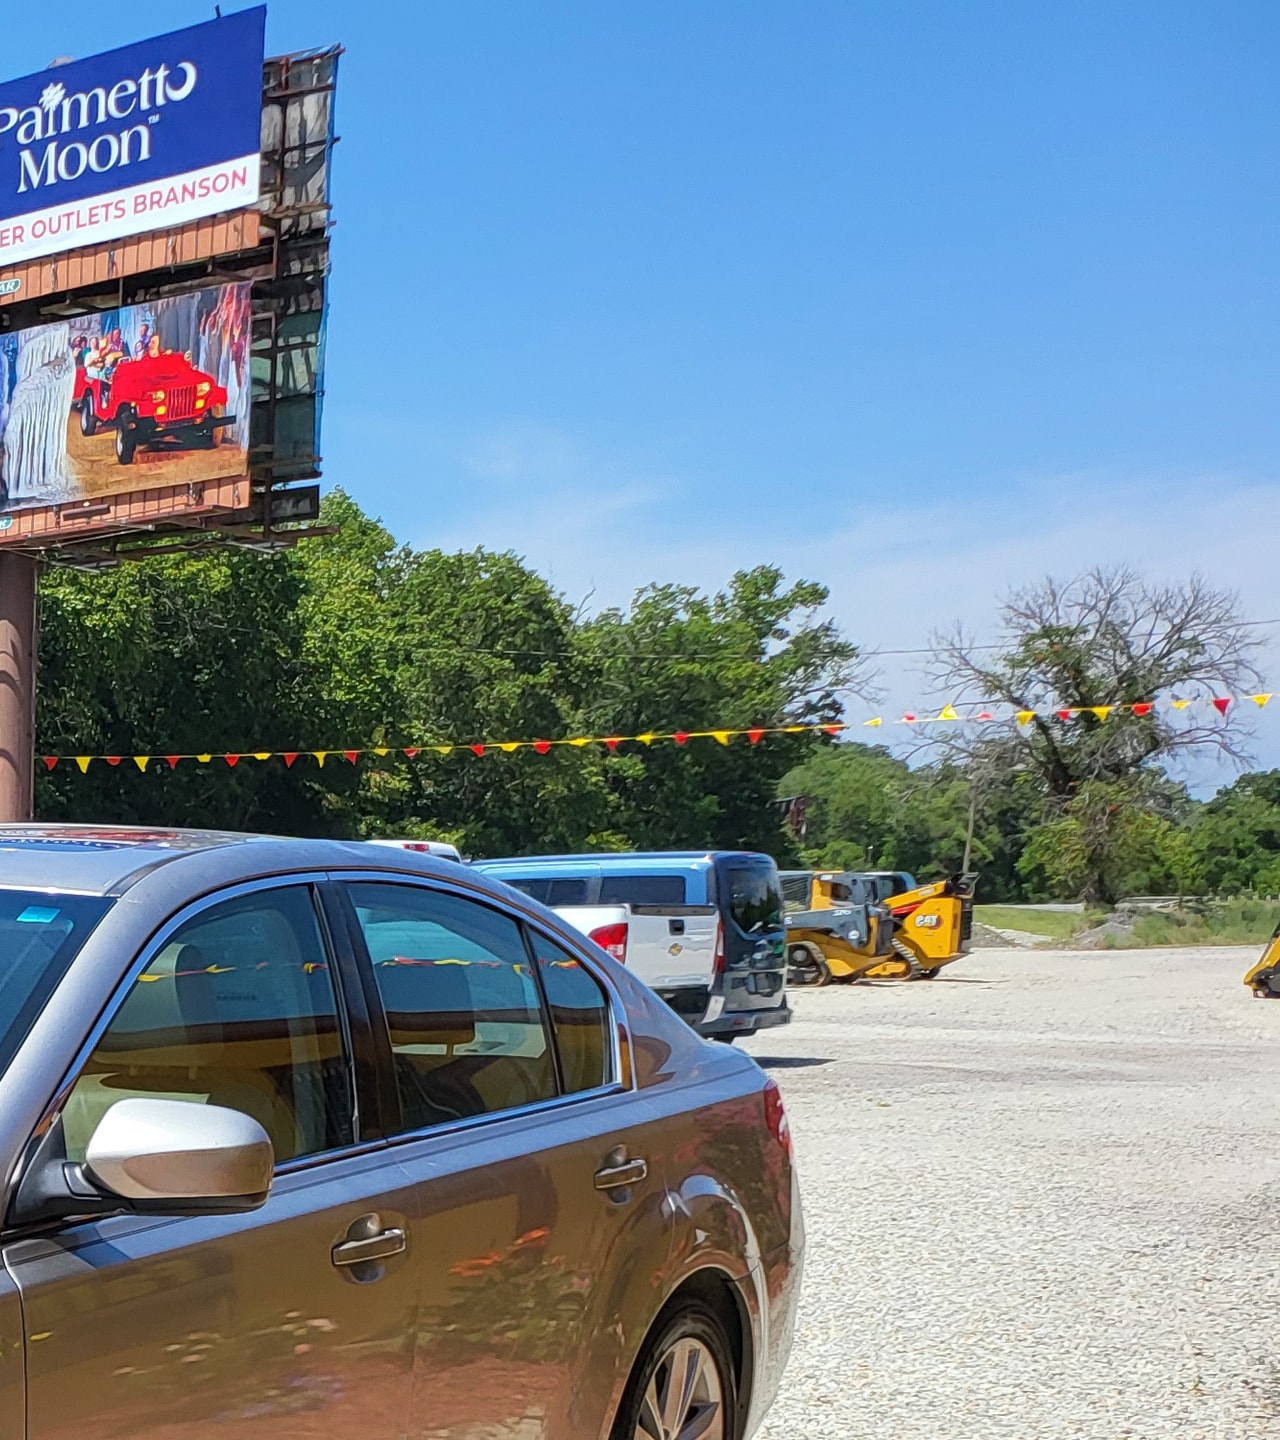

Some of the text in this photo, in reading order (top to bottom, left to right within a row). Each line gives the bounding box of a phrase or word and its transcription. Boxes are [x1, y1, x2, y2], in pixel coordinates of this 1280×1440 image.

[16, 124, 151, 194] Moon
[31, 202, 126, 239] OUTLETS
[133, 166, 248, 216] BRANSON
